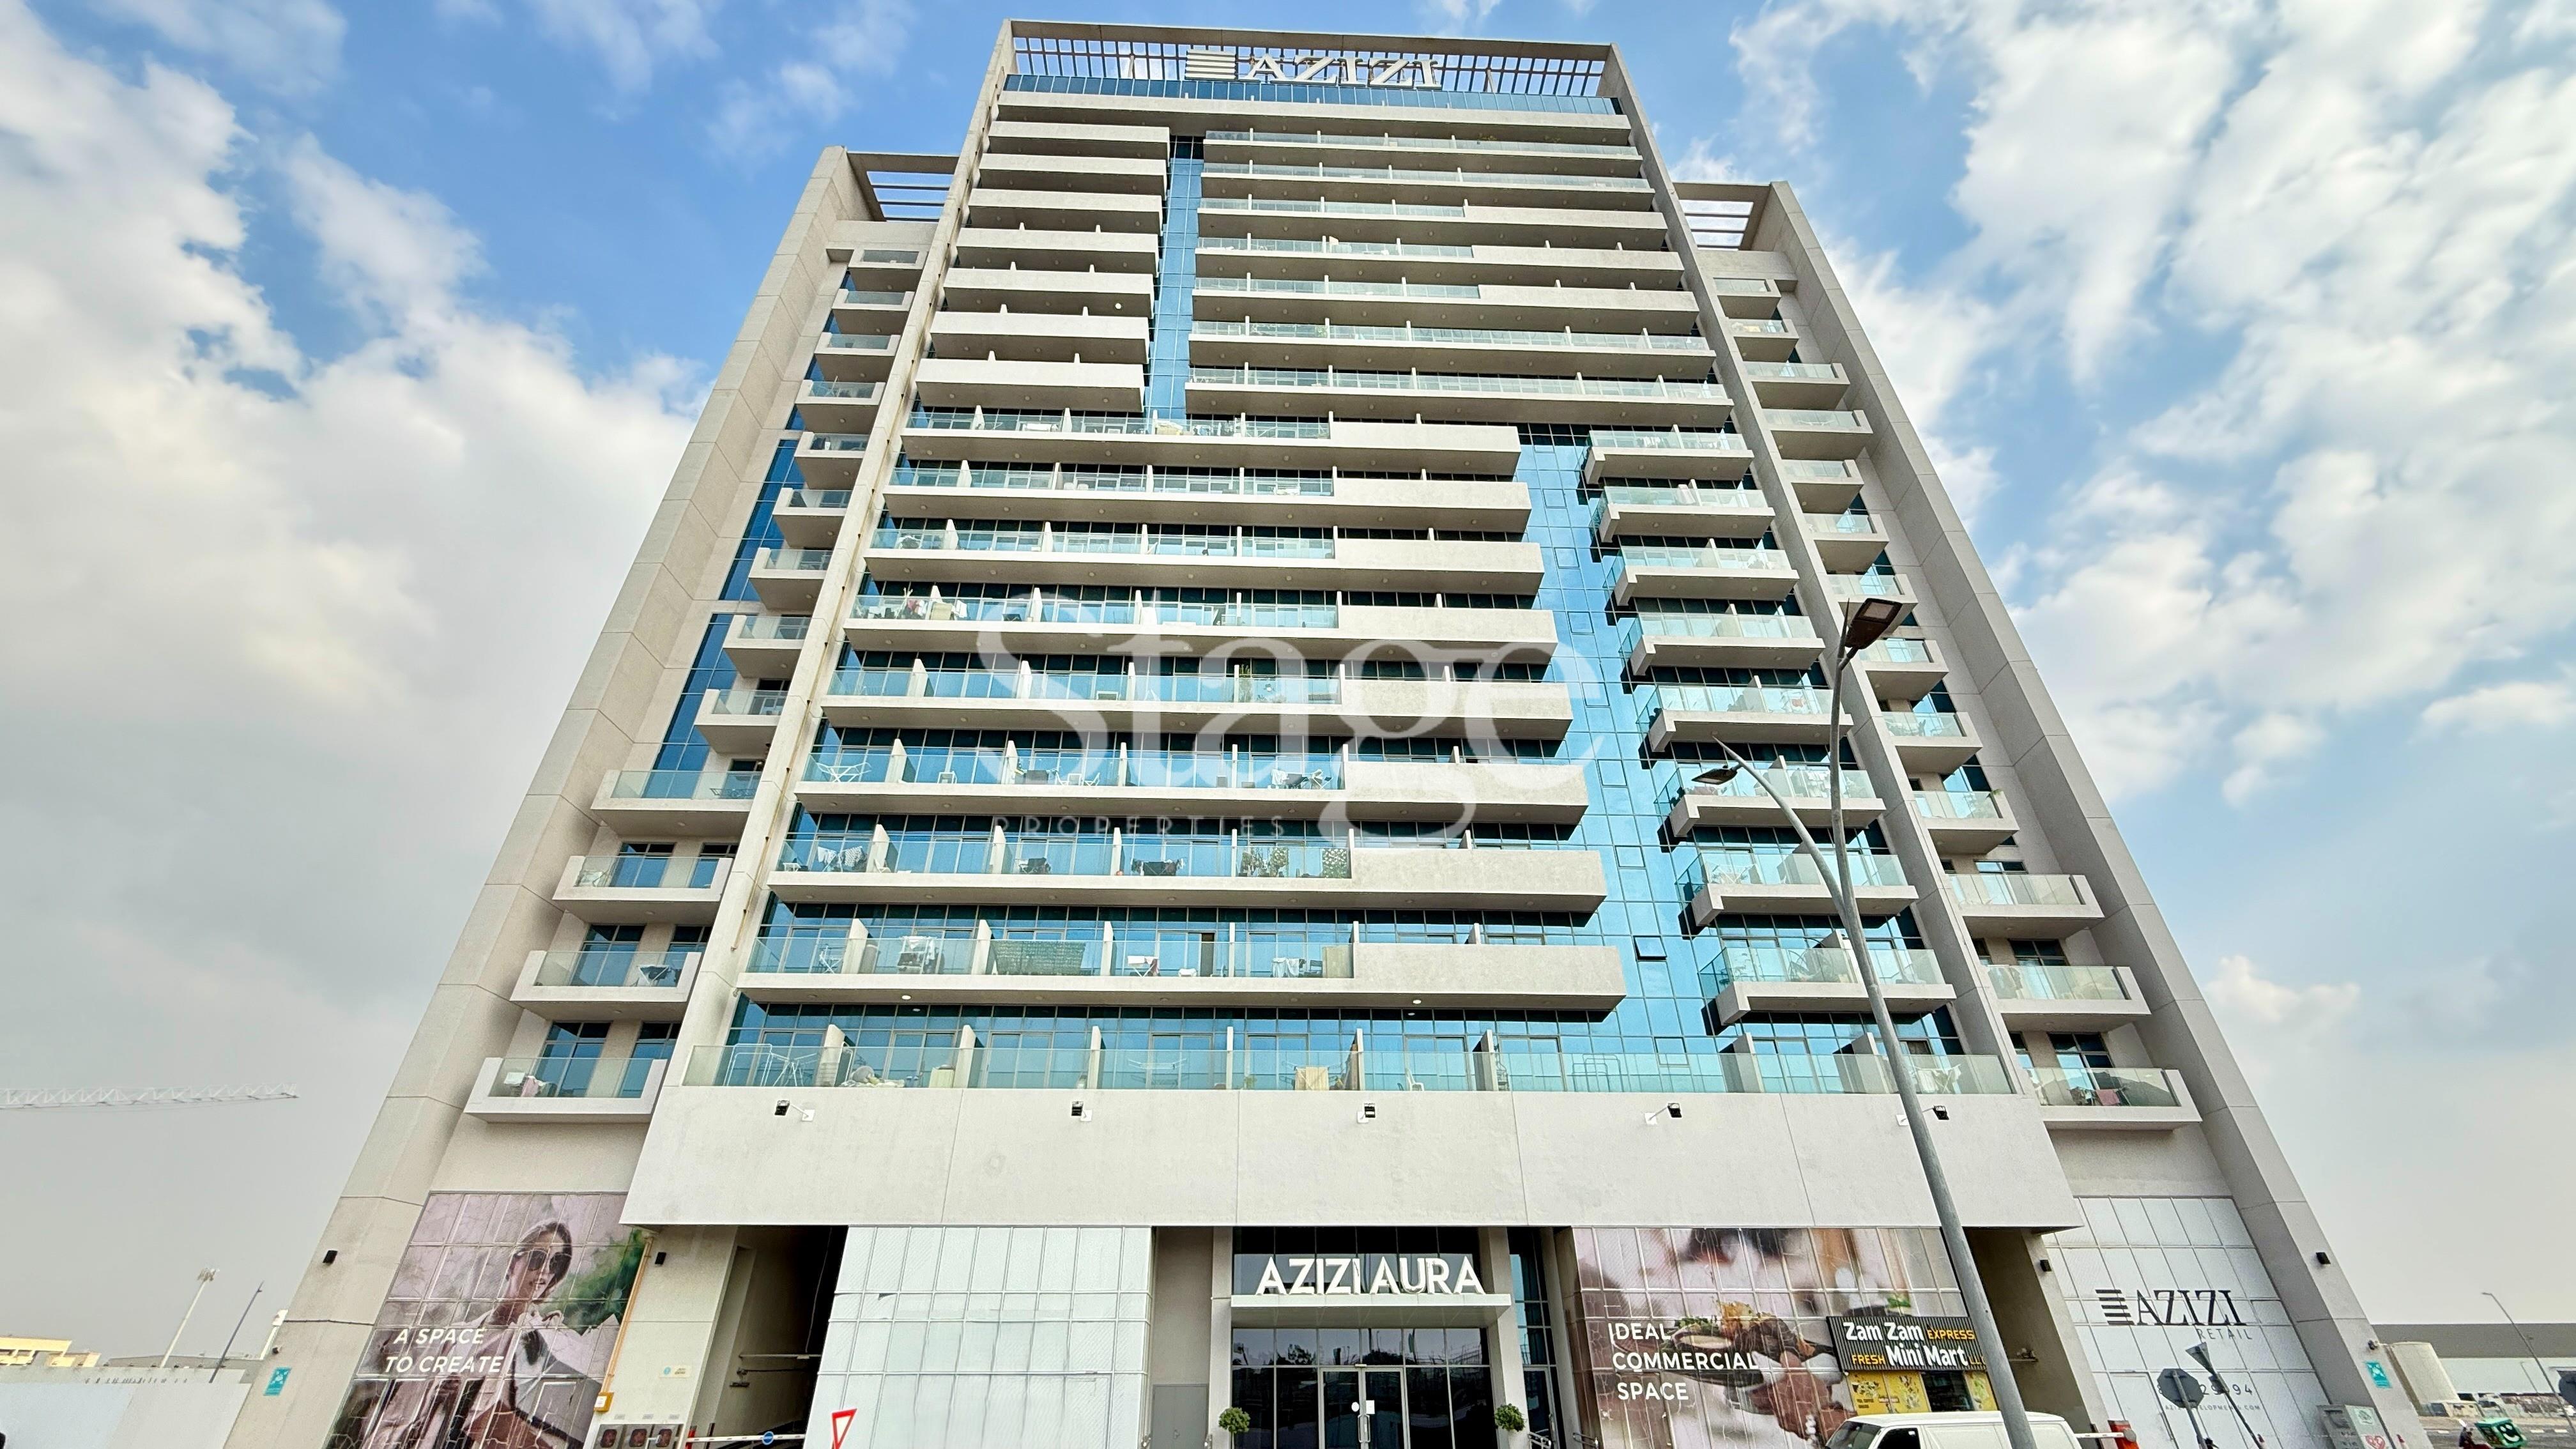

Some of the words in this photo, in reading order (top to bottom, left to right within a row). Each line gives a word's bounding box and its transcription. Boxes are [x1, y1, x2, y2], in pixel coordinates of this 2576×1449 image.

[1239, 54, 1443, 90] AZIZI
[1255, 1256, 1361, 1295] AZIZI
[1370, 1256, 1486, 1295] AURA
[2136, 1289, 2248, 1326] AZIZI
[393, 1328, 408, 1344] A
[416, 1328, 486, 1344] SPACE
[1608, 1322, 1672, 1340] IDEAL
[1843, 1322, 1883, 1341] Zam
[1884, 1322, 1925, 1342] Zam
[1927, 1329, 1975, 1340] EXPRESS
[2196, 1328, 2253, 1340] RETAIL
[1612, 1351, 1759, 1370] COMMERCIAL
[1852, 1354, 1885, 1365] FRESH
[1885, 1342, 1925, 1367] Mini
[1923, 1345, 1968, 1367] Mart
[385, 1356, 413, 1373] TO
[418, 1356, 504, 1373] CREATE
[1617, 1381, 1689, 1400] SPACE
